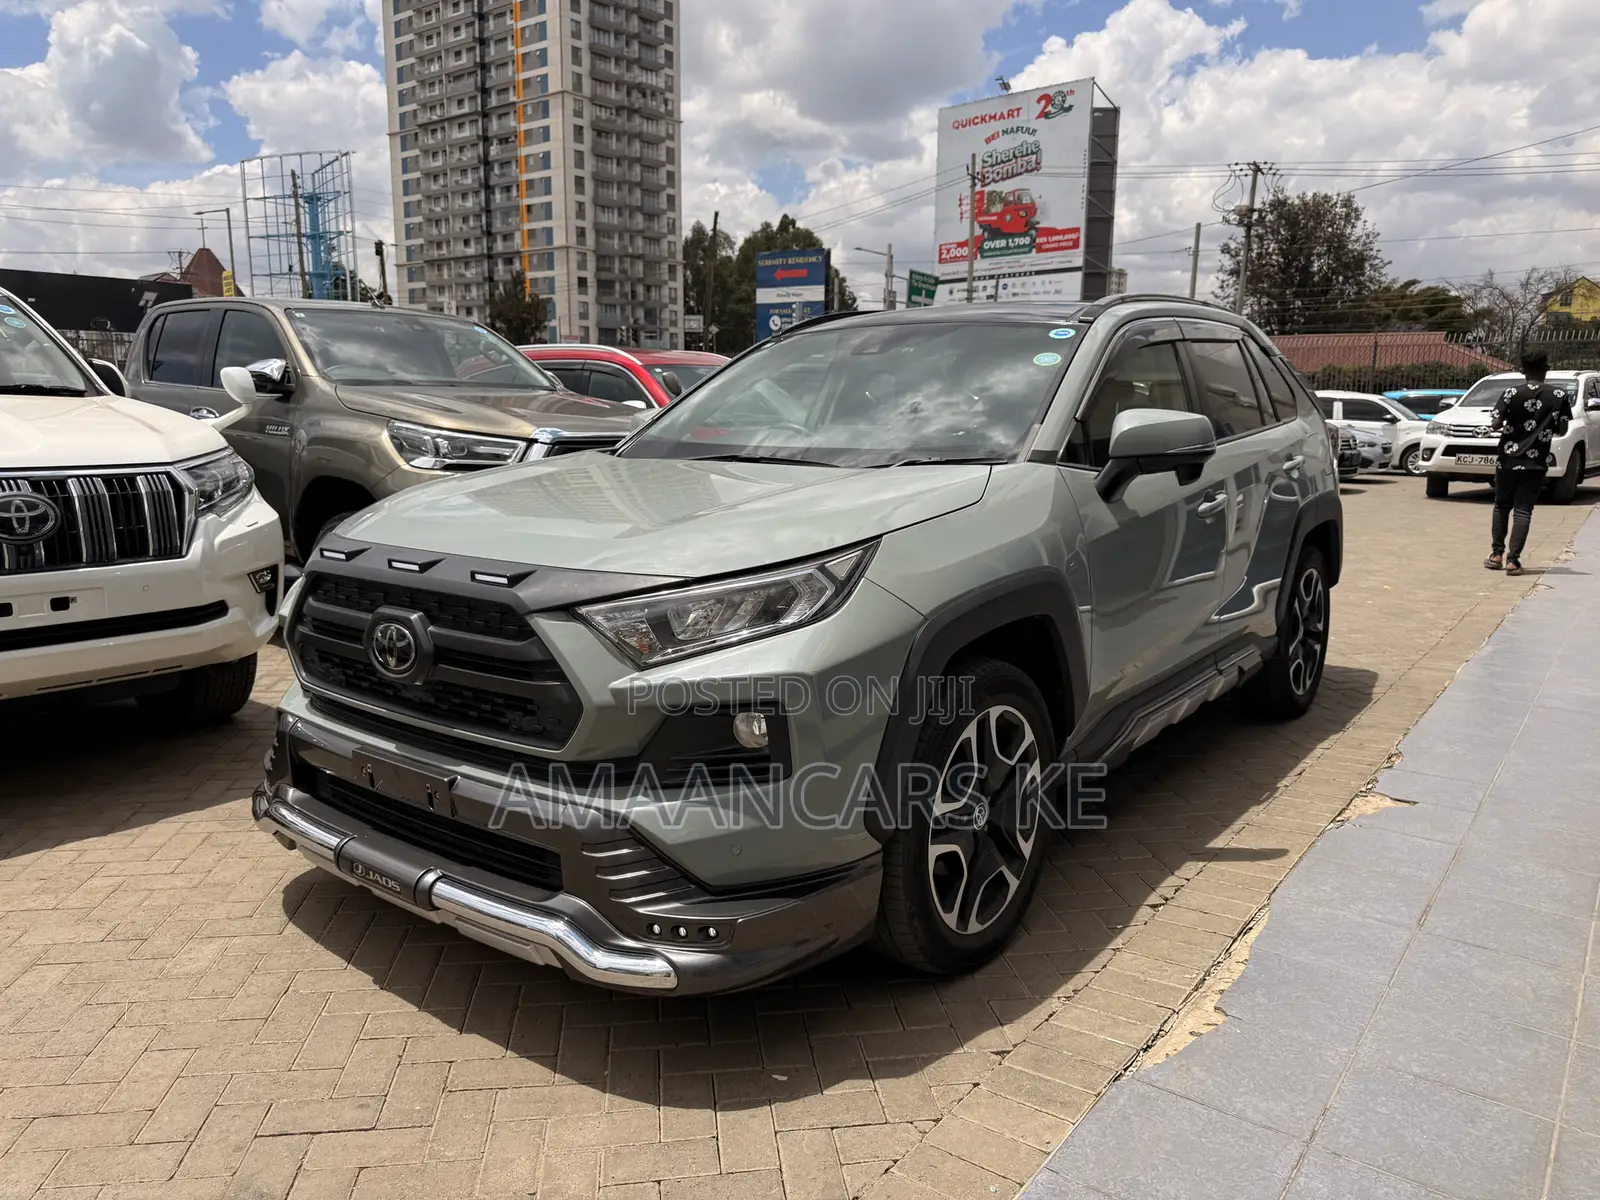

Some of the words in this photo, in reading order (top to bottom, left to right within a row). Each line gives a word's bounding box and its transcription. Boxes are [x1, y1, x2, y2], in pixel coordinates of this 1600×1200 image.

[952, 107, 1022, 130] QUICKMART
[984, 130, 1000, 145] BEI
[1001, 126, 1038, 137] NAFUU!
[982, 140, 1040, 167] Sherehe
[981, 149, 1042, 187] Bomba!
[983, 239, 1007, 250] OVER
[1008, 236, 1031, 248] 1,700
[1457, 455, 1475, 464] KCJ
[1477, 456, 1498, 465] 786
[366, 870, 401, 892] JAOS
